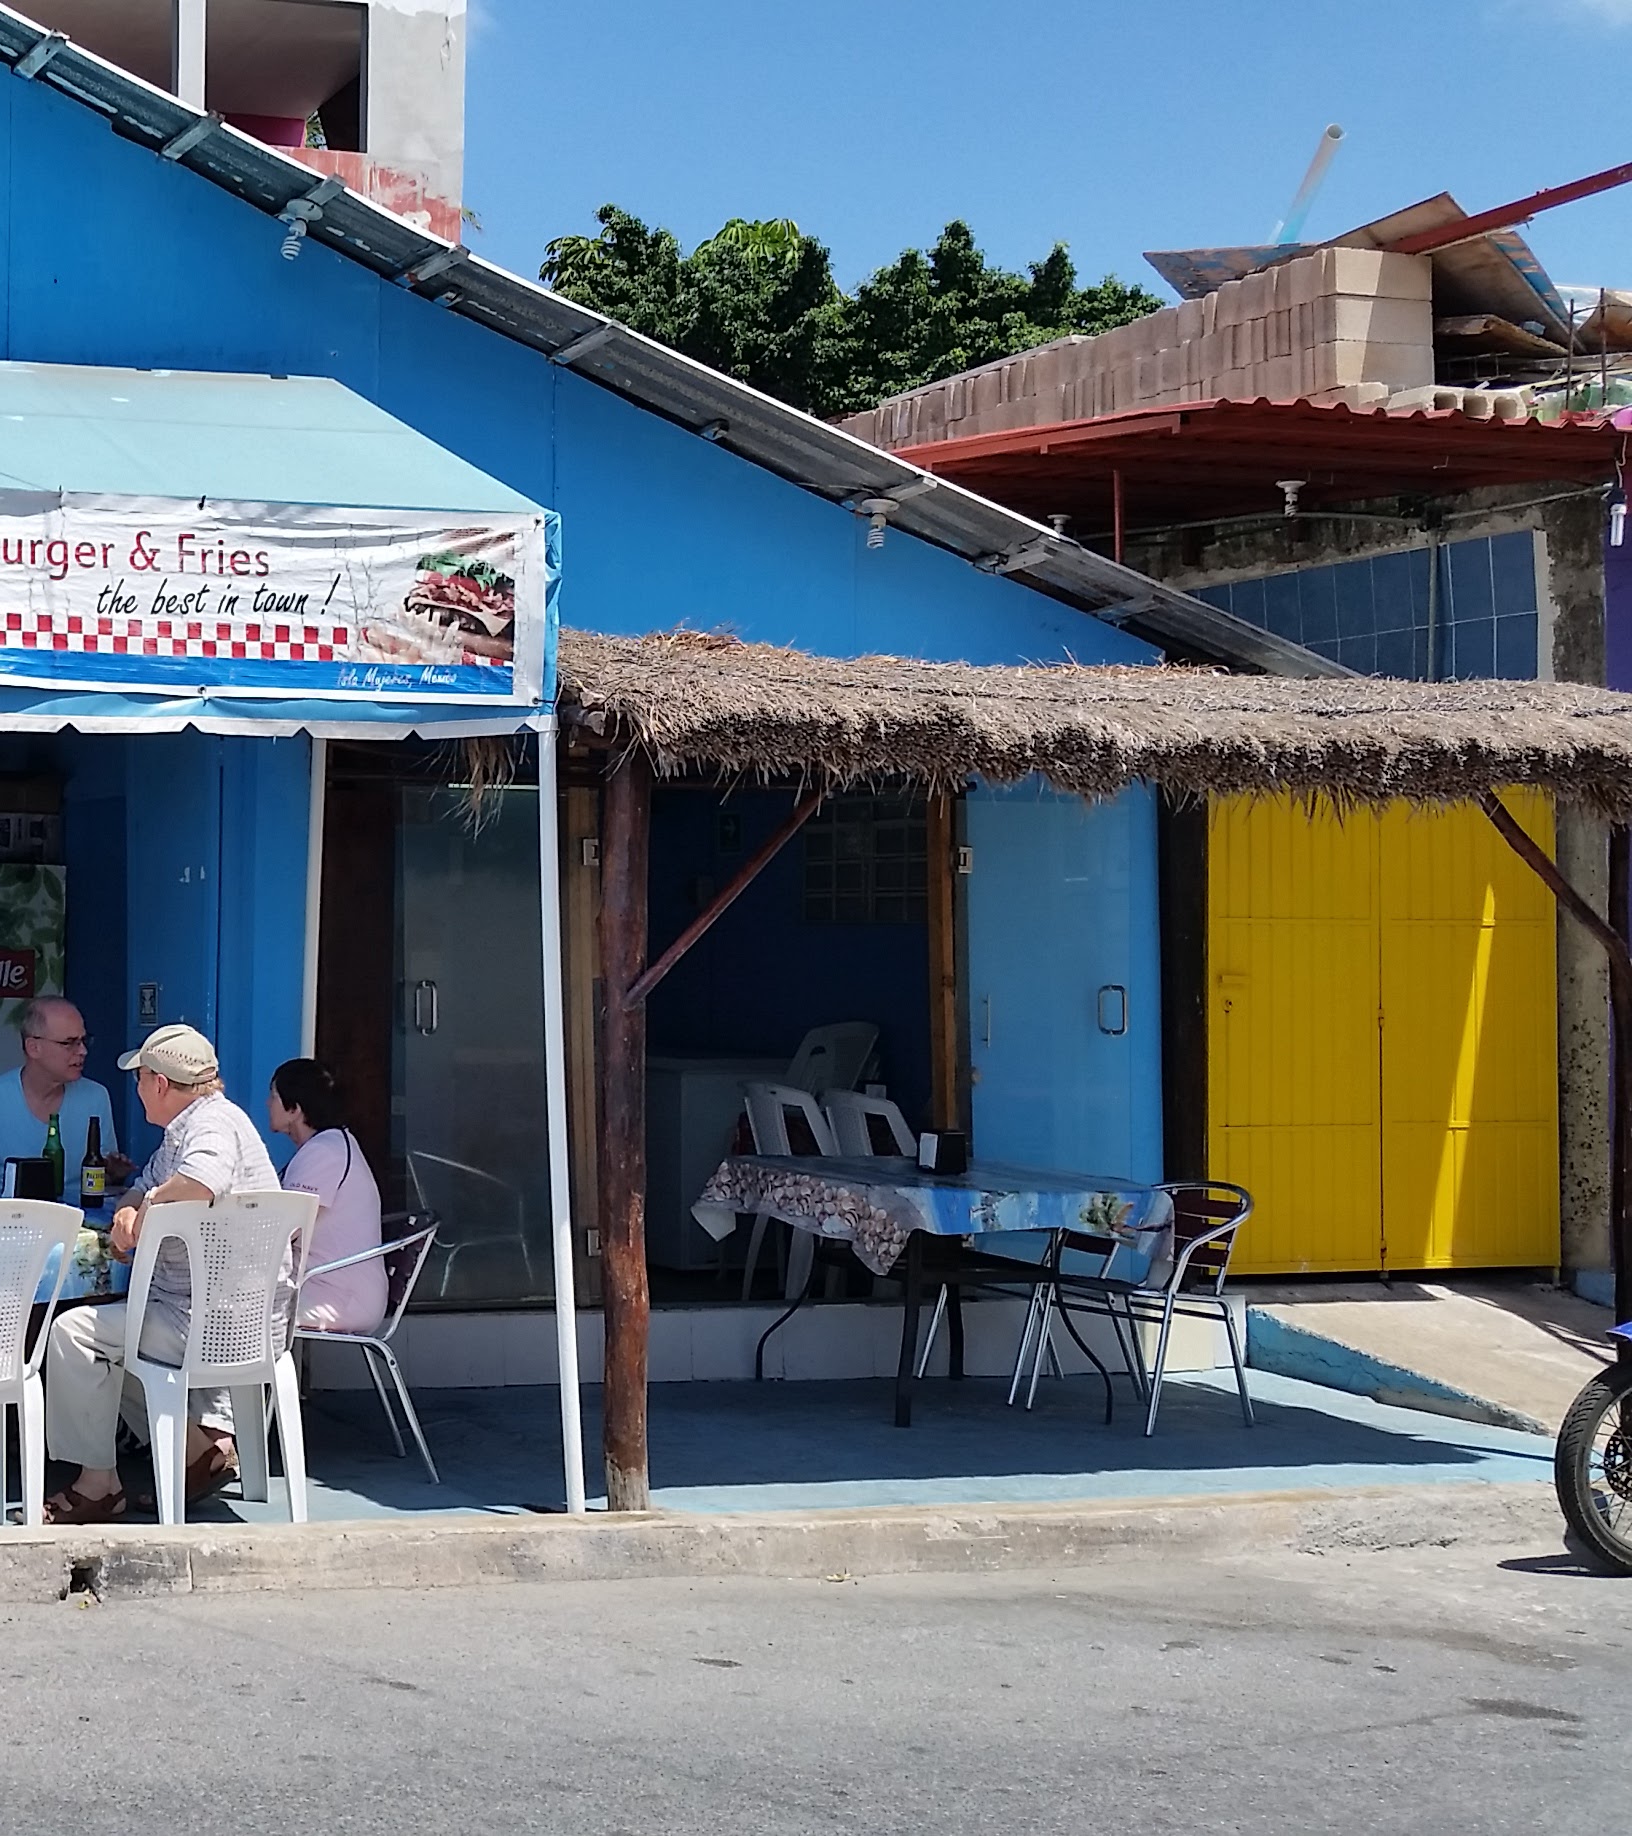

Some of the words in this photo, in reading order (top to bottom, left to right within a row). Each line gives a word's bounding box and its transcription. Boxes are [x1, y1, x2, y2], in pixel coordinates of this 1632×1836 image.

[129, 530, 161, 573] &
[176, 533, 271, 578] Fries
[96, 579, 139, 617] the
[148, 581, 209, 618] best
[216, 584, 240, 617] in
[252, 586, 310, 617] town
